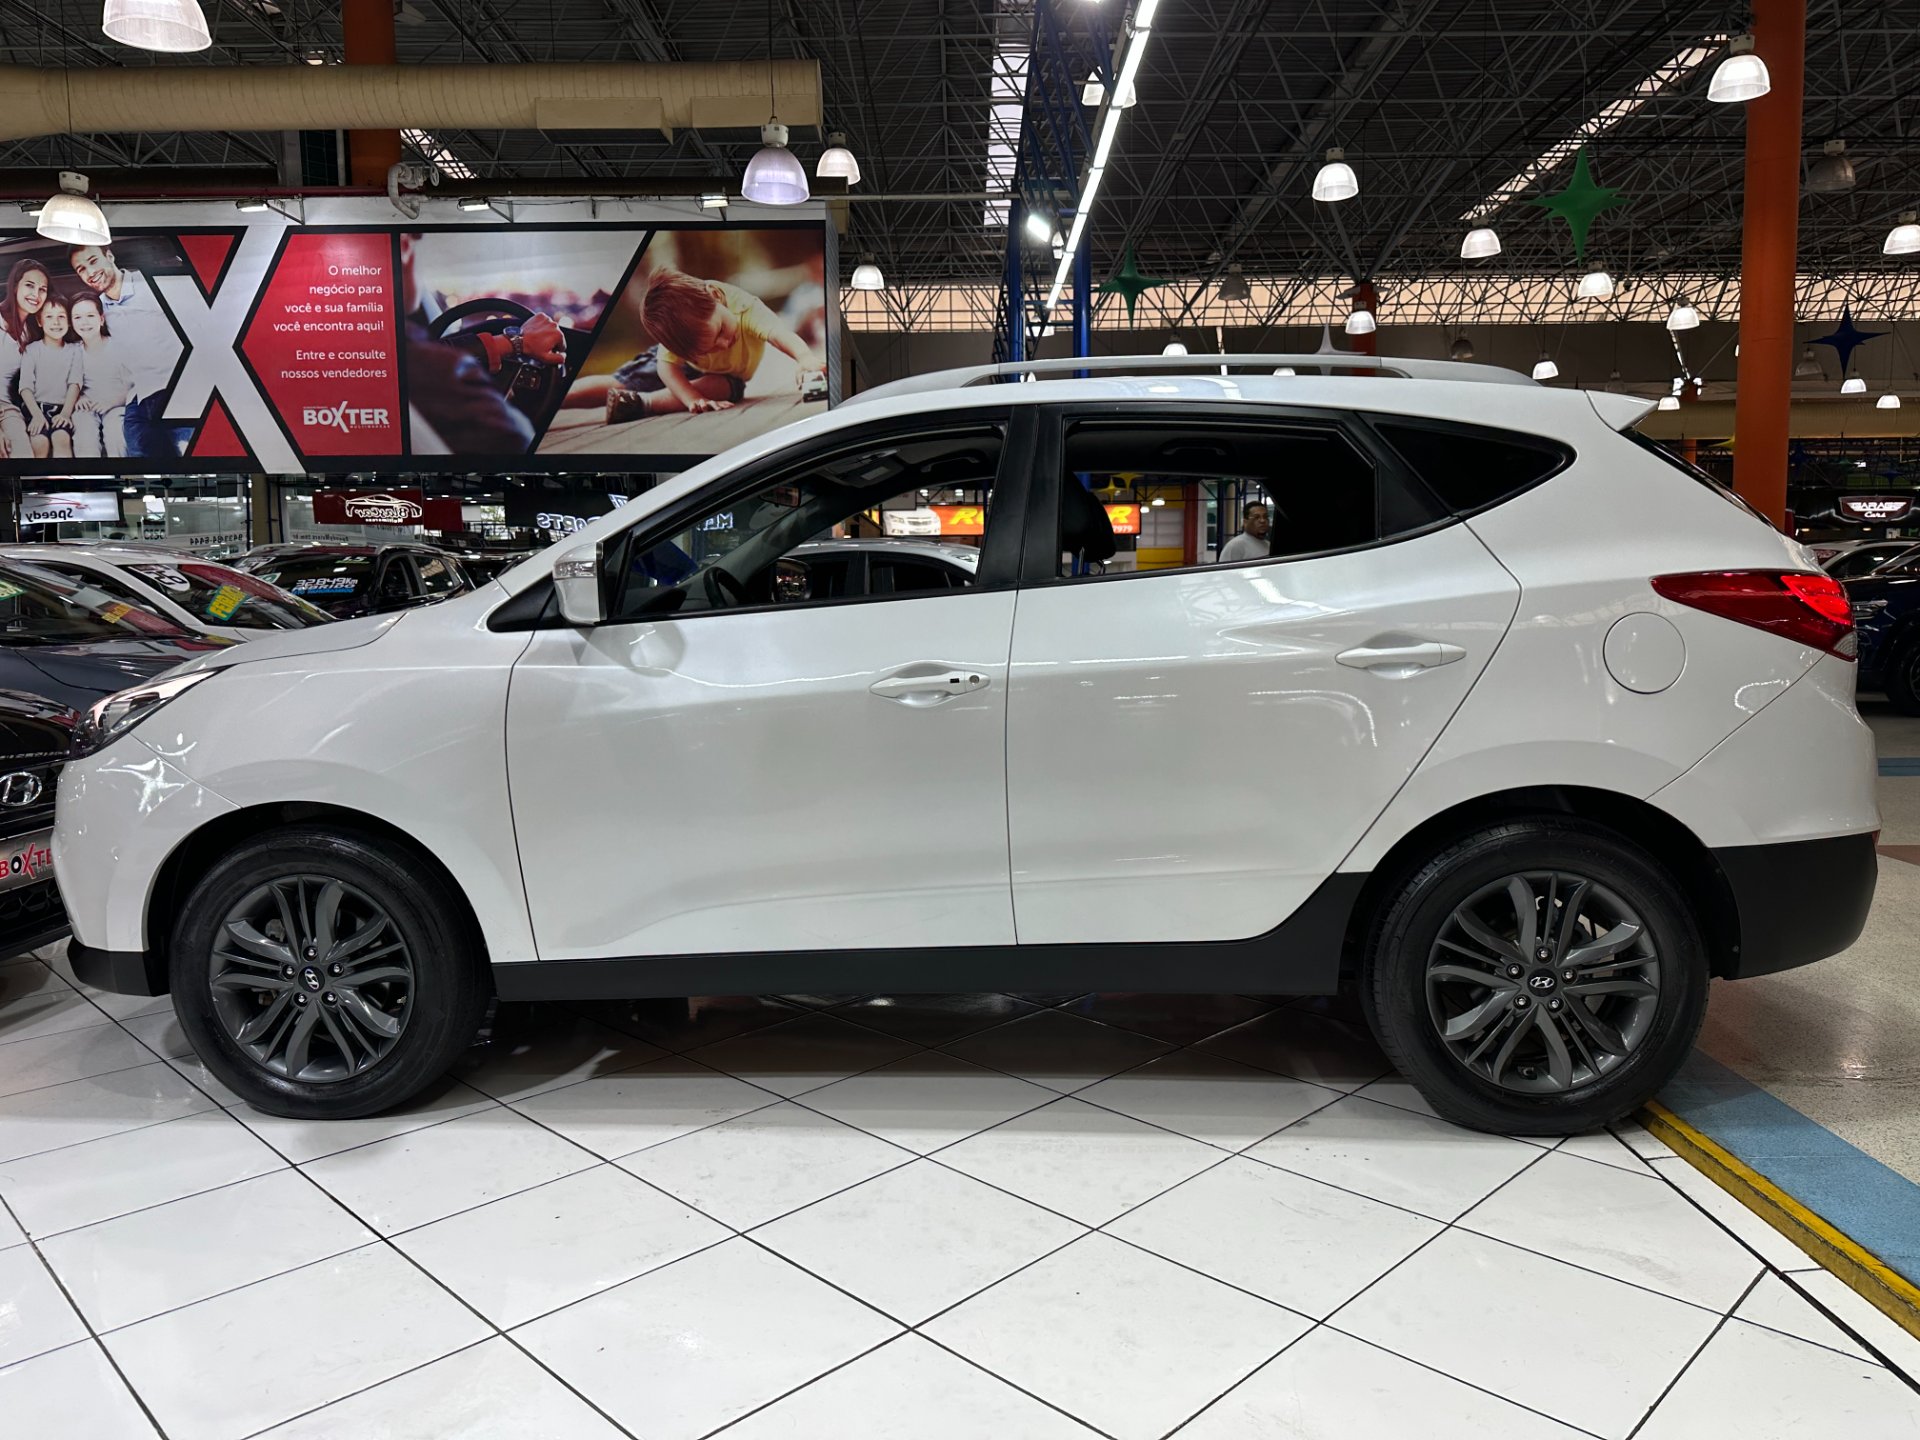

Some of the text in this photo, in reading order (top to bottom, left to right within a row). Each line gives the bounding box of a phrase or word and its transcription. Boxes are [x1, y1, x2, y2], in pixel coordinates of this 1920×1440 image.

[328, 265, 382, 276] O melhor
[309, 284, 383, 297] negócio para
[284, 302, 384, 313] você e sua família
[273, 320, 385, 334] você encontra aqui!
[296, 349, 387, 360] Entre e consulte
[281, 368, 388, 379] nossos vendedores
[303, 401, 390, 433] BOXTER
